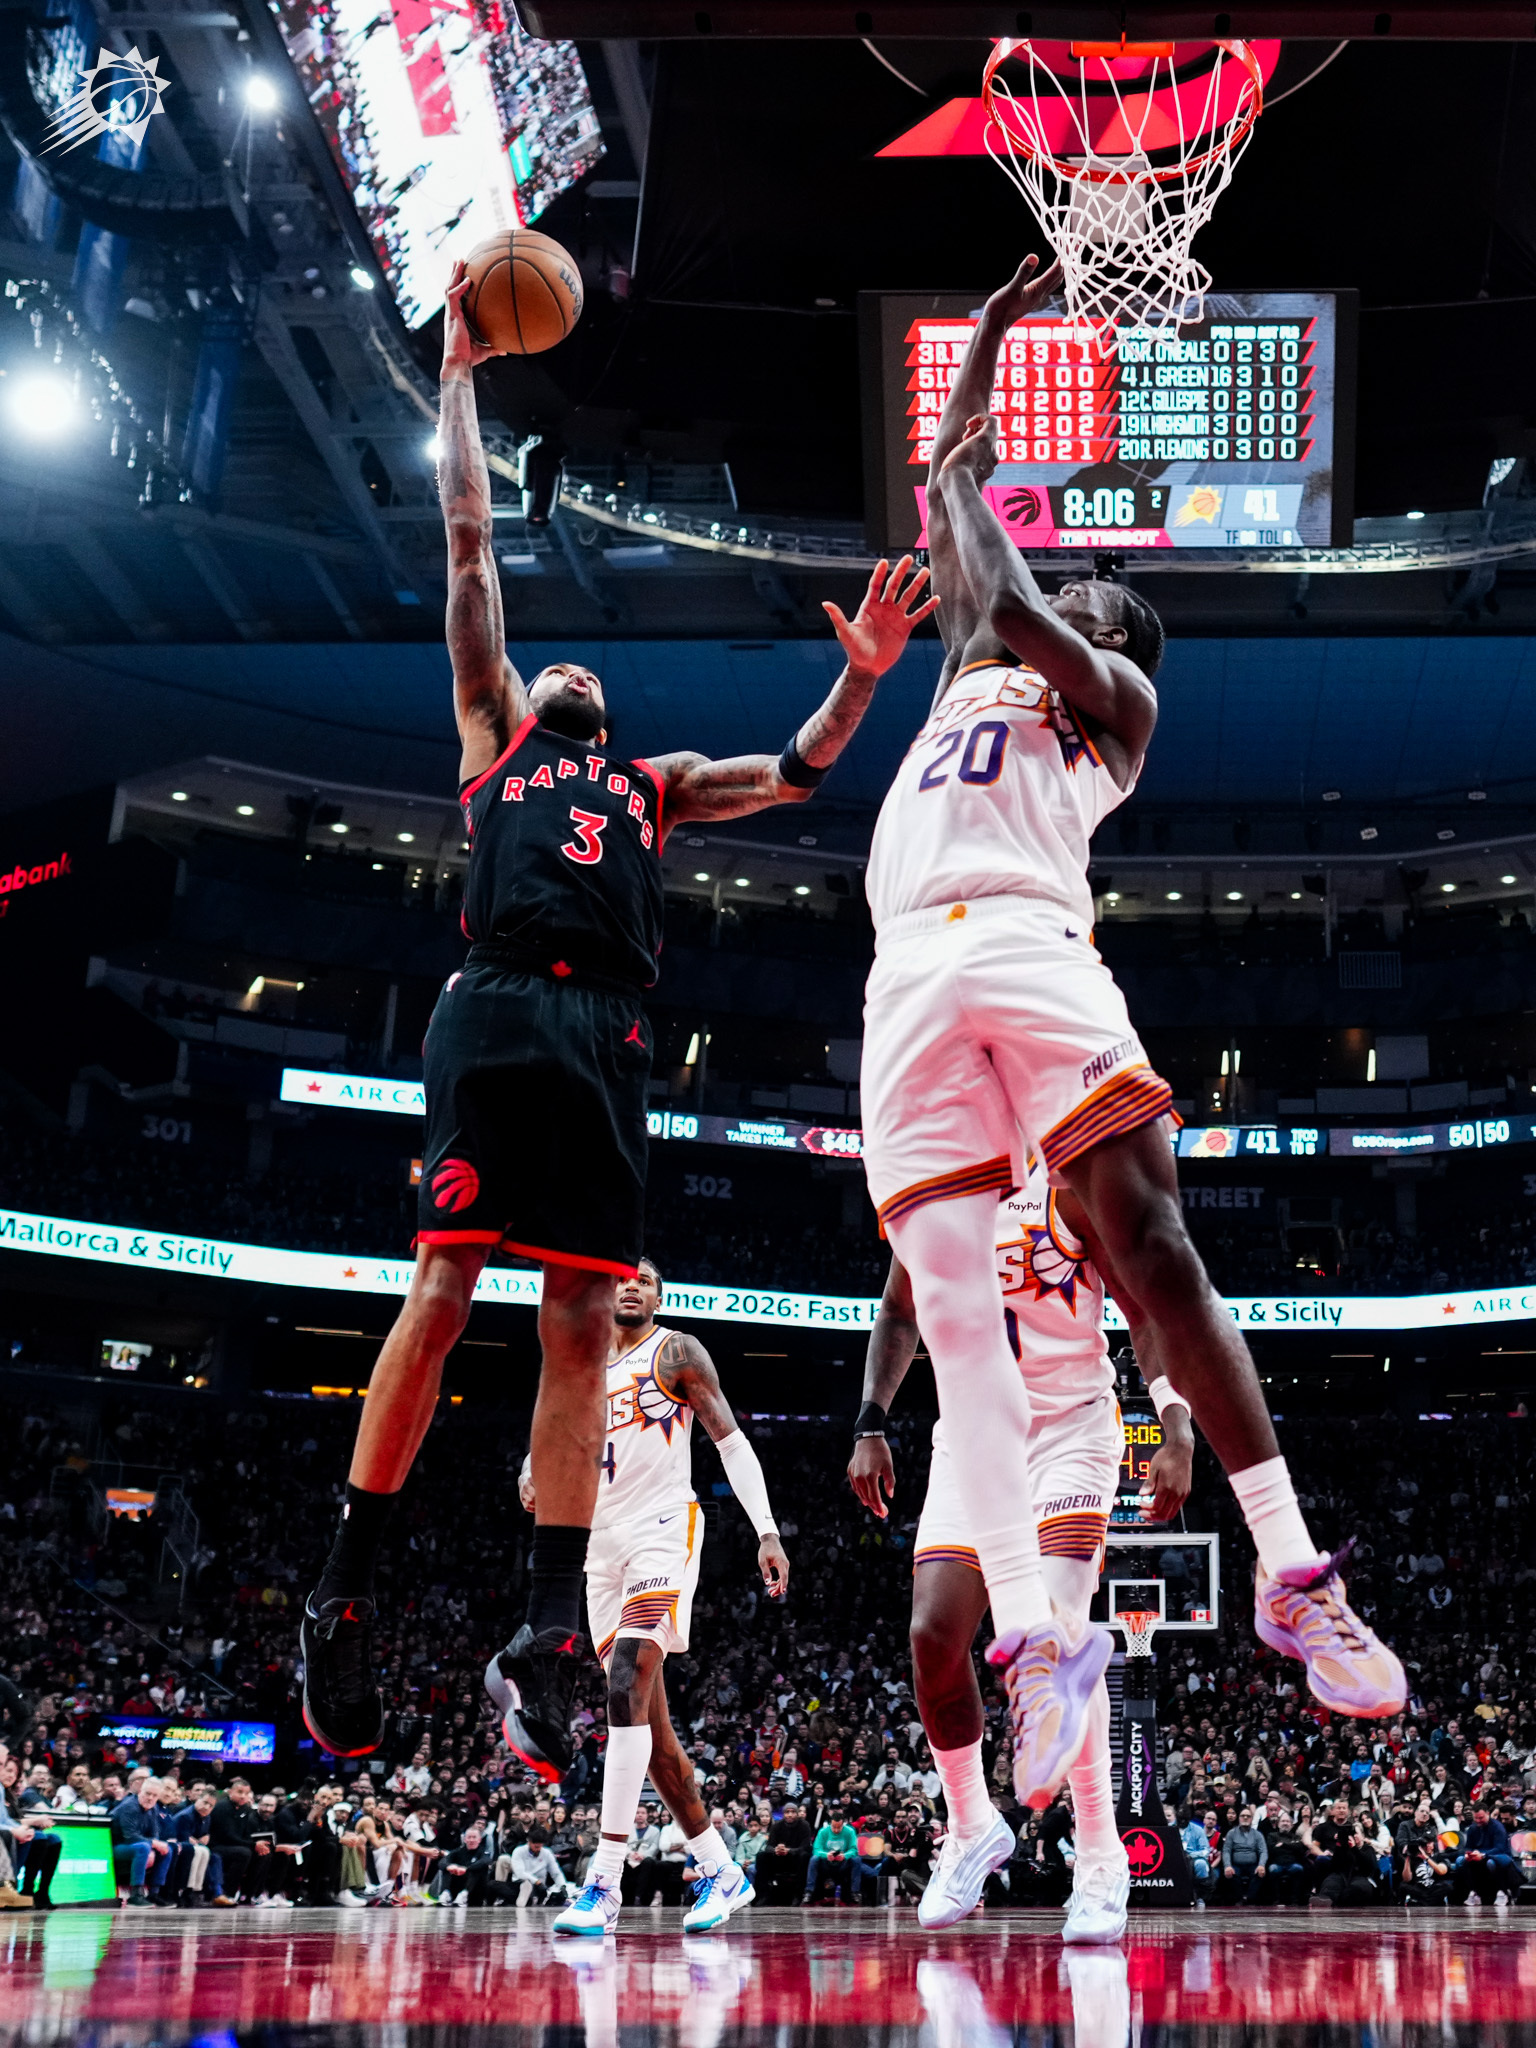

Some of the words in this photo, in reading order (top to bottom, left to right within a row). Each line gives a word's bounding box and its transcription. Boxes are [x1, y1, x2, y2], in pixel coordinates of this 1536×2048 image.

[918, 343, 934, 363] 3
[1010, 343, 1026, 363] 6
[1033, 343, 1048, 363] 3
[1057, 343, 1070, 363] 1
[1080, 343, 1092, 363] 1
[1213, 341, 1229, 362] 0
[1237, 341, 1252, 362] 2
[1260, 341, 1275, 362] 3
[1282, 341, 1298, 362] 0
[918, 367, 934, 388] 5
[1010, 367, 1026, 388] 6
[1035, 367, 1048, 388] 1
[1055, 367, 1072, 388] 0
[1078, 367, 1094, 388] 0
[1121, 366, 1137, 387] 4
[1155, 366, 1209, 387] GREEN
[1211, 366, 1232, 387] 16
[1236, 366, 1252, 387] 3
[1262, 366, 1274, 387] 1
[1281, 366, 1298, 387] 0
[1010, 391, 1027, 412] 4
[1034, 391, 1049, 412] 2
[1056, 391, 1072, 412] 0
[1078, 391, 1094, 412] 2
[1119, 390, 1140, 411] 12
[1213, 390, 1229, 411] 0
[1237, 390, 1252, 411] 2
[1259, 390, 1275, 411] 0
[1281, 390, 1297, 411] 0
[1011, 416, 1027, 437] 4
[1034, 416, 1049, 437] 2
[1056, 416, 1072, 437] 0
[1078, 416, 1094, 437] 2
[1119, 414, 1140, 436] 19
[1213, 414, 1229, 436] 3
[1236, 414, 1252, 436] 0
[1259, 414, 1275, 436] 0
[1281, 414, 1297, 436] 0
[1012, 440, 1027, 461] 3
[1034, 440, 1049, 461] 0
[1057, 440, 1072, 461] 2
[1080, 440, 1092, 461] 1
[1118, 439, 1140, 460] 20
[1154, 439, 1209, 460] FLEMING
[1213, 439, 1229, 460] 0
[1236, 439, 1251, 460] 3
[1258, 439, 1275, 460] 0
[1280, 439, 1297, 460] 0
[1063, 488, 1135, 526] 8:06
[1151, 490, 1162, 509] 2
[1243, 489, 1280, 521] 41
[1225, 531, 1239, 545] TF
[1259, 531, 1280, 545] TOL
[919, 721, 1011, 792] 20
[502, 755, 653, 849] RAPTORS
[560, 805, 608, 865] 3
[339, 1085, 382, 1101] AIR
[142, 1114, 192, 1144] 301
[726, 1130, 762, 1145] TAKES
[763, 1134, 797, 1148] HOME
[739, 1122, 786, 1137] WINNER
[1246, 1131, 1280, 1154] 41
[684, 1173, 733, 1199] 302
[1008, 1202, 1042, 1213] PayPal
[1180, 1187, 1264, 1208] TREET
[0, 1217, 119, 1253] Mallorca
[128, 1236, 149, 1257] &
[157, 1240, 233, 1274] Sicily
[725, 1293, 799, 1318] 2026:
[808, 1300, 861, 1322] Fast
[1249, 1303, 1266, 1321] &
[1275, 1301, 1343, 1326] Sicily
[1473, 1298, 1512, 1312] AIR
[1044, 1494, 1102, 1517] PHOENIX
[626, 1577, 671, 1599] PHOENIX
[1130, 1722, 1143, 1755] CITY
[1130, 1755, 1143, 1817] JACKPOT
[1129, 1879, 1174, 1887] CANADA
